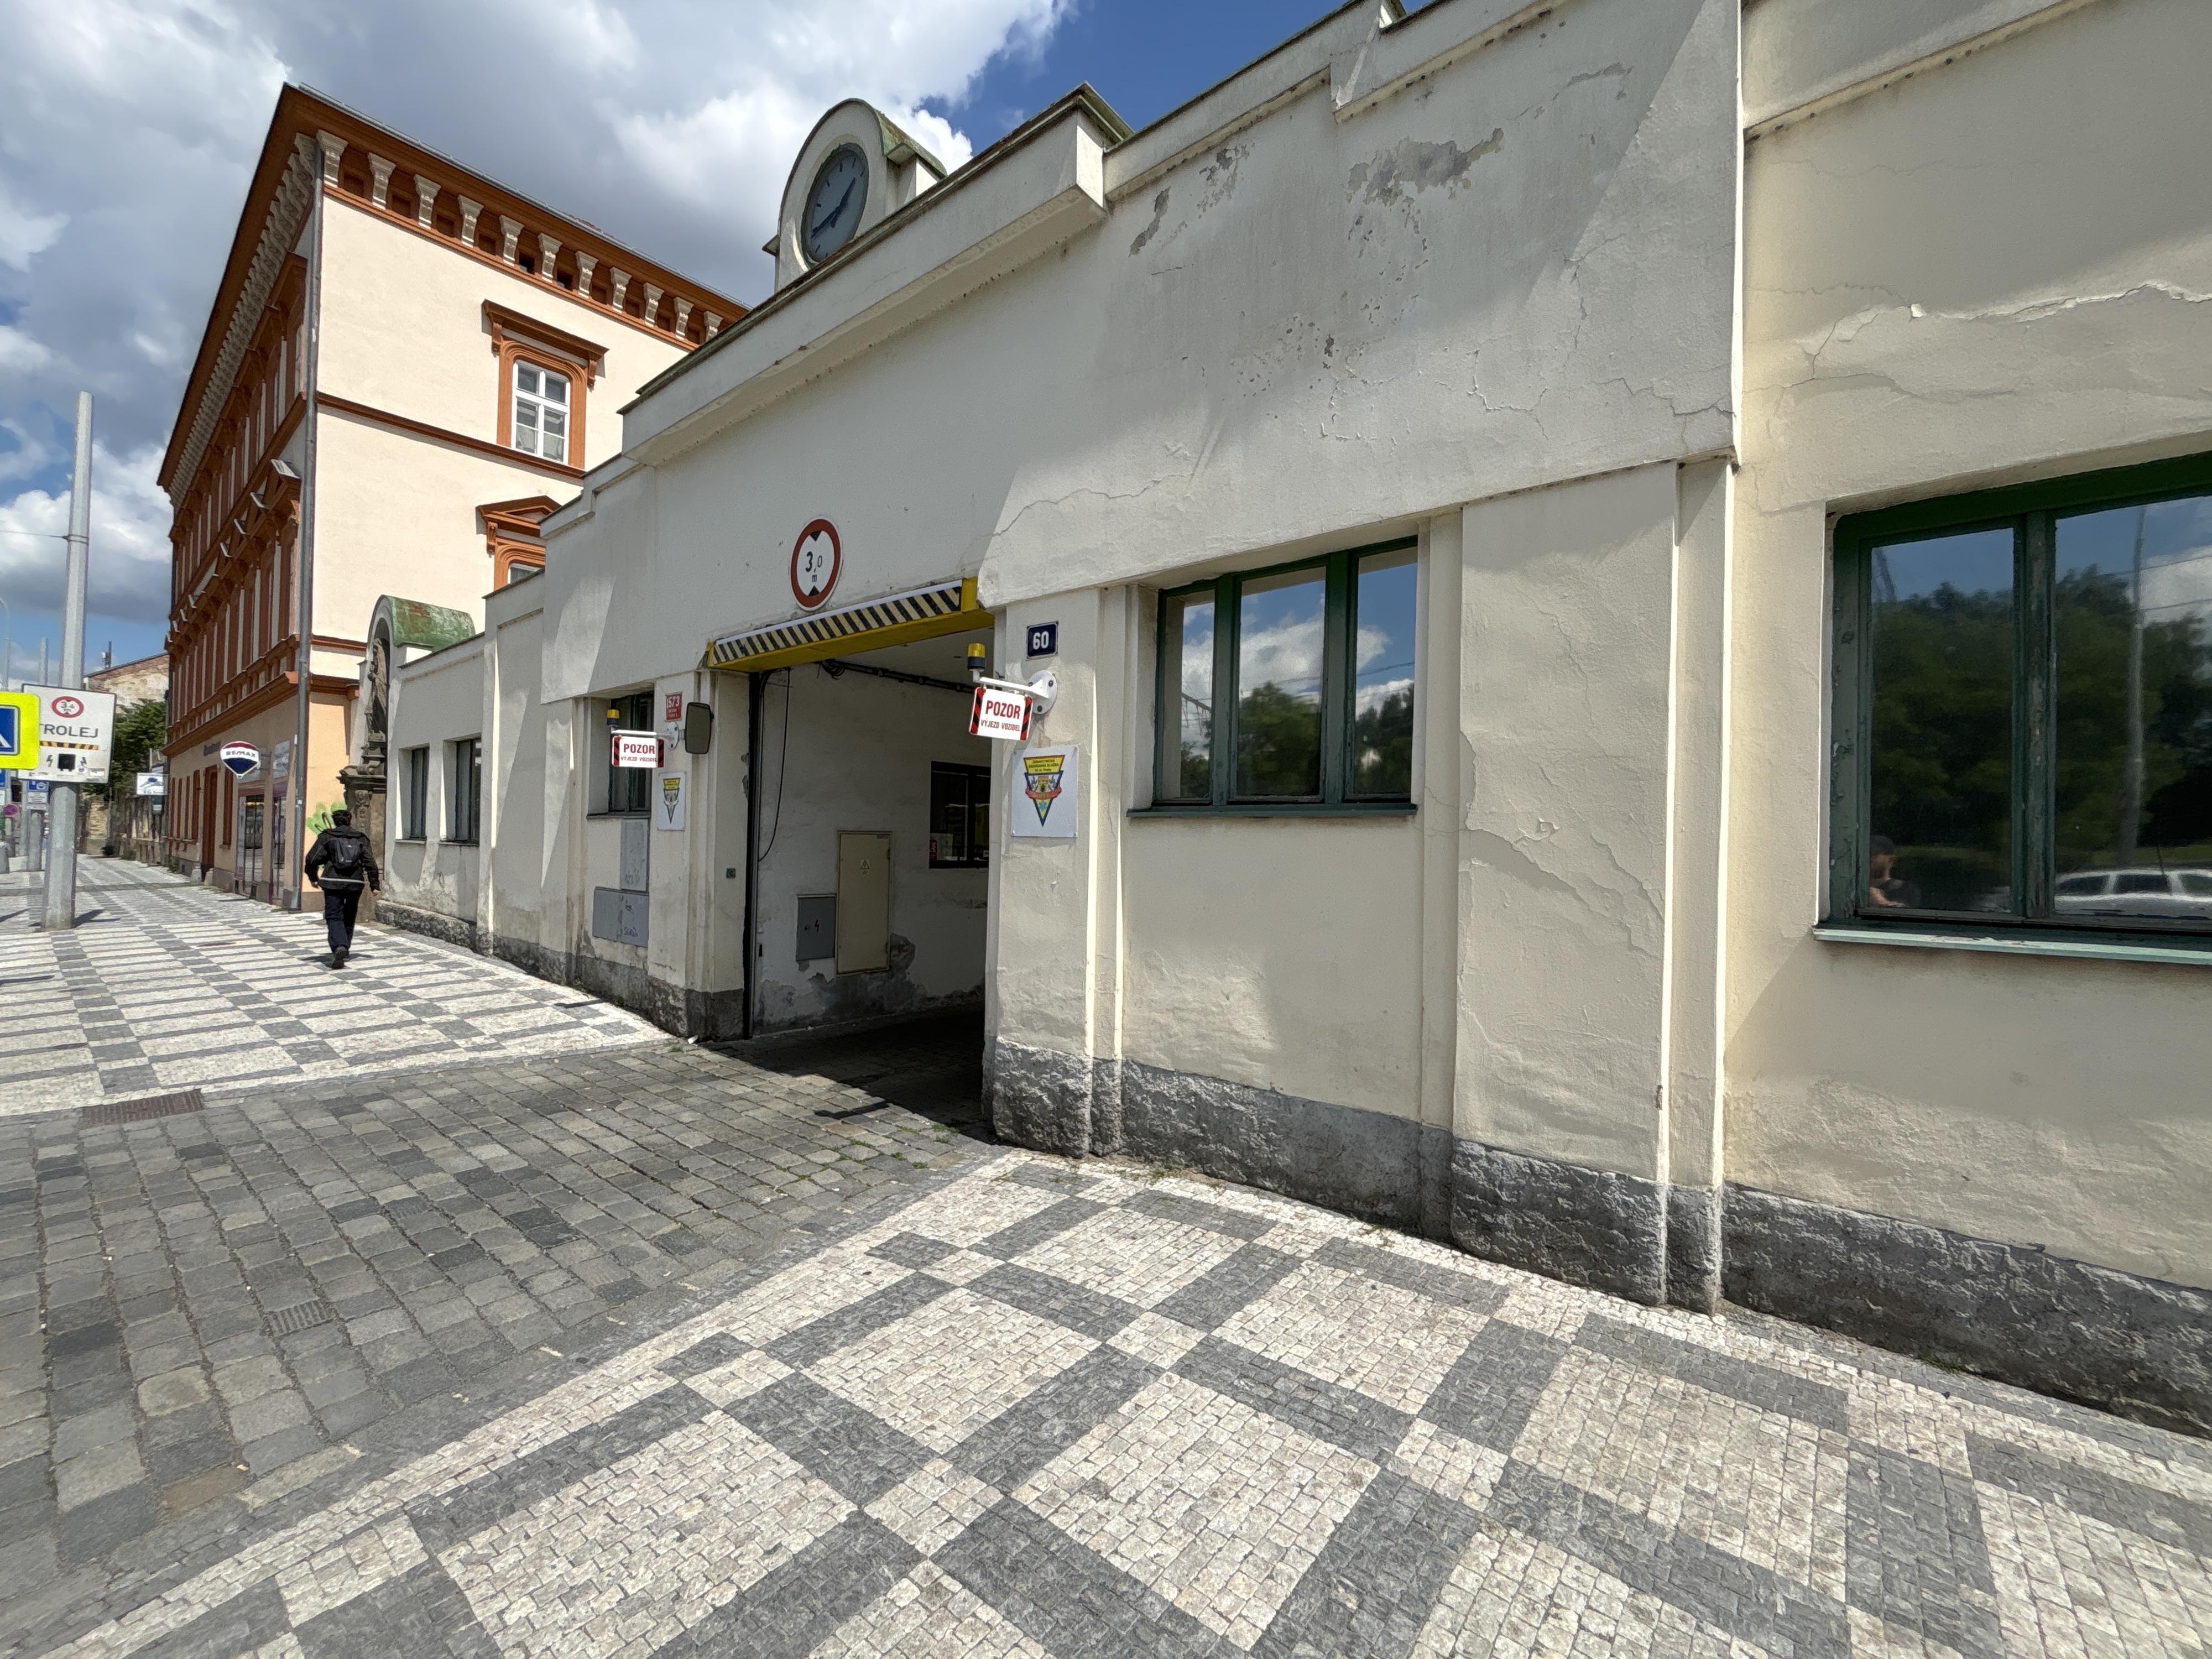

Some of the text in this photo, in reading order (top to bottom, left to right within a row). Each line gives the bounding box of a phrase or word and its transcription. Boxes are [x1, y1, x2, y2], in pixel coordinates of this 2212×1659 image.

[812, 574, 817, 582] m
[1033, 631, 1050, 650] 60
[666, 696, 680, 708] 1573
[985, 700, 1021, 719] POZOR
[980, 718, 1020, 732] VÝJEZD VOZIDEL
[623, 743, 655, 754] POZOR
